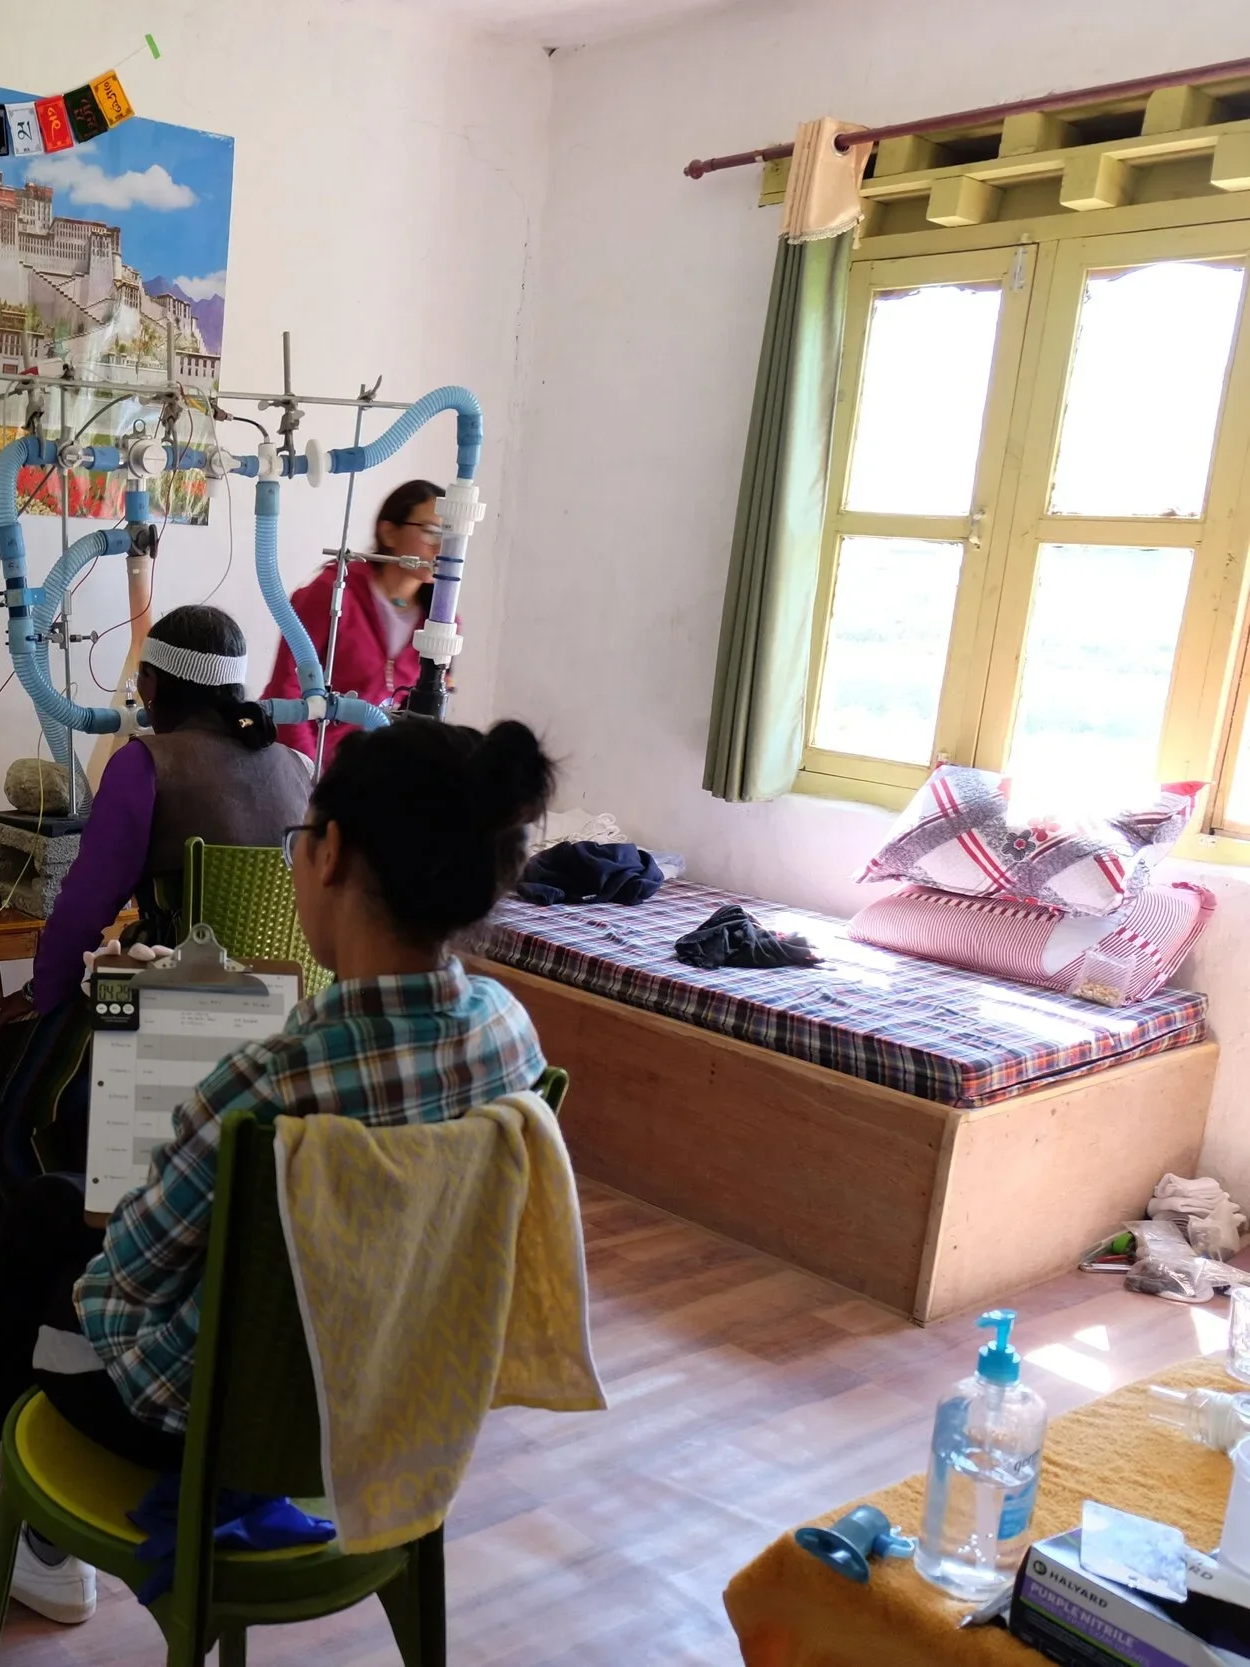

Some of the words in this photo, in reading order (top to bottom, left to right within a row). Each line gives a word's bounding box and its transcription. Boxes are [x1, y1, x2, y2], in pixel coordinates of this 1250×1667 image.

[1030, 1582, 1079, 1619] PURPLE
[1080, 1610, 1134, 1648] NITRILE
[1049, 1571, 1108, 1608] HALYARD
